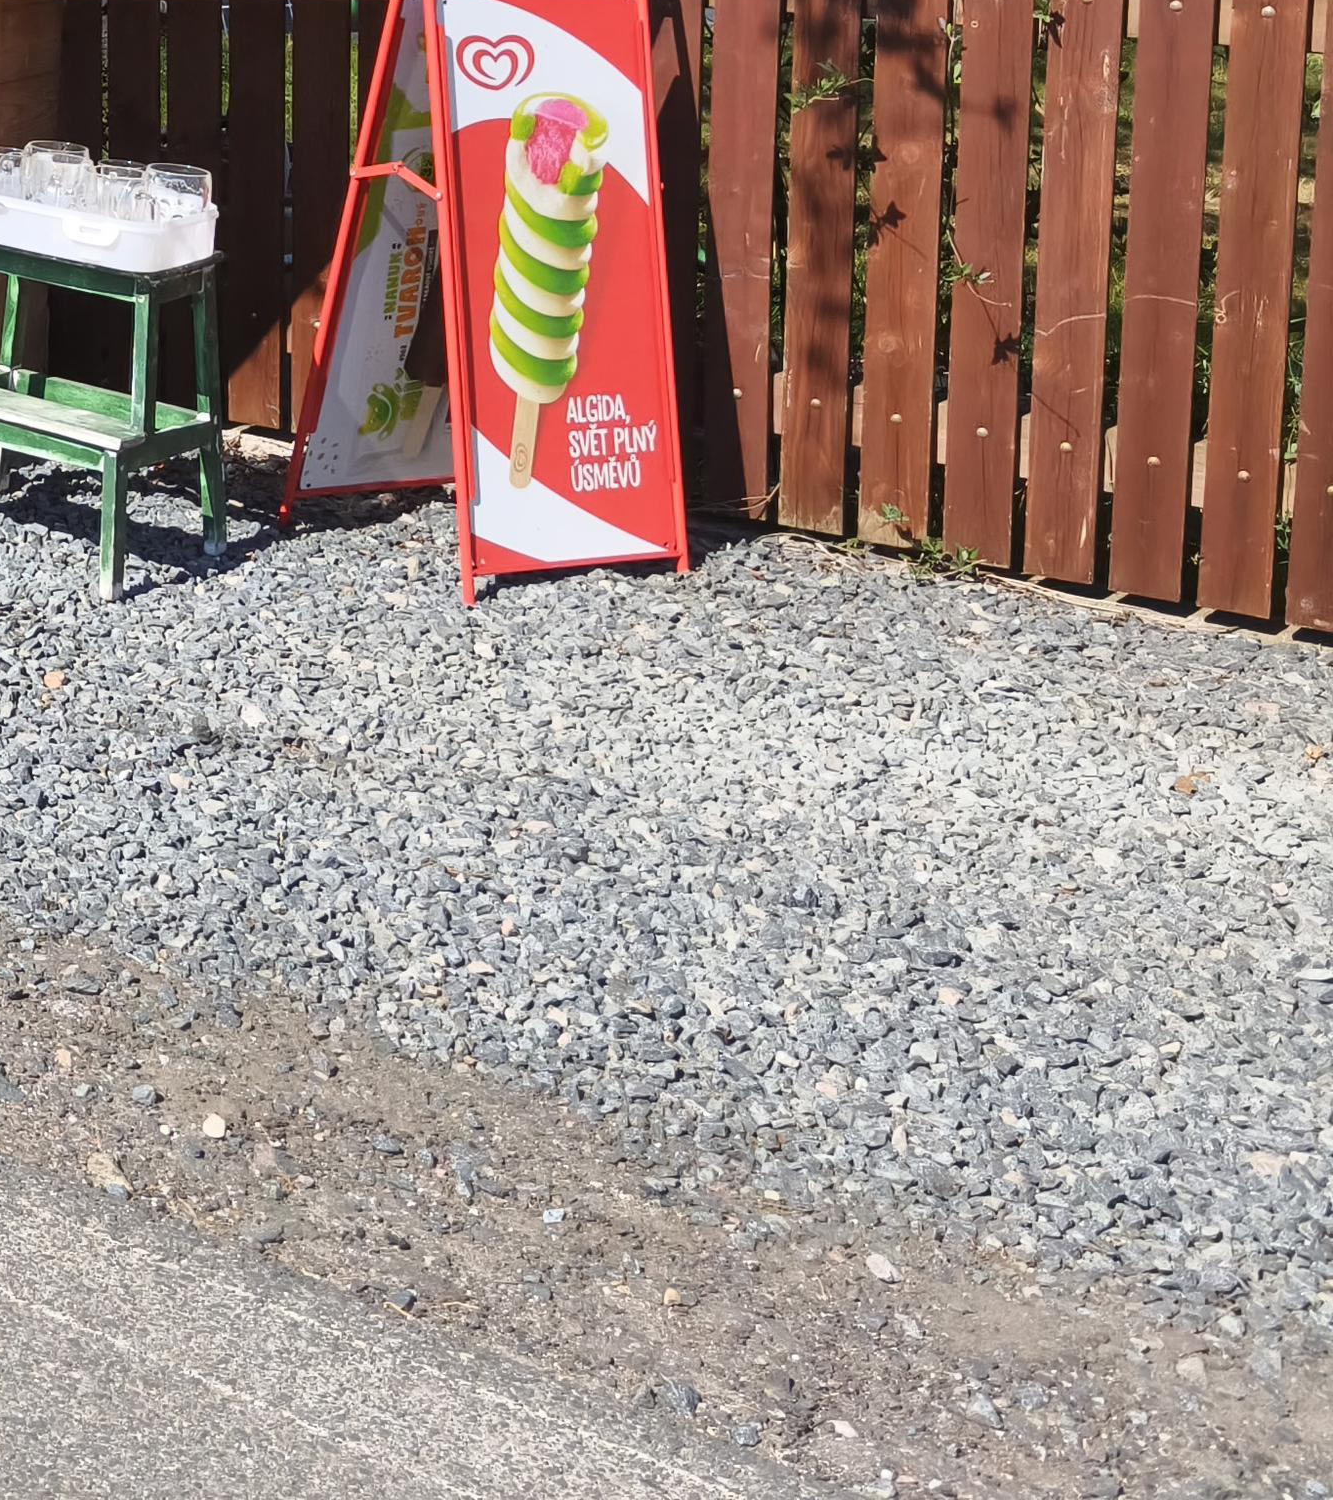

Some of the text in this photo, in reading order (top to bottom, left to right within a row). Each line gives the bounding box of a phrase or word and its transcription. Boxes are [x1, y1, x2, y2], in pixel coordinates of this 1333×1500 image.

[568, 419, 657, 458] SVĚT PLNÝ
[570, 453, 641, 492] ÚSMĚVŮ
